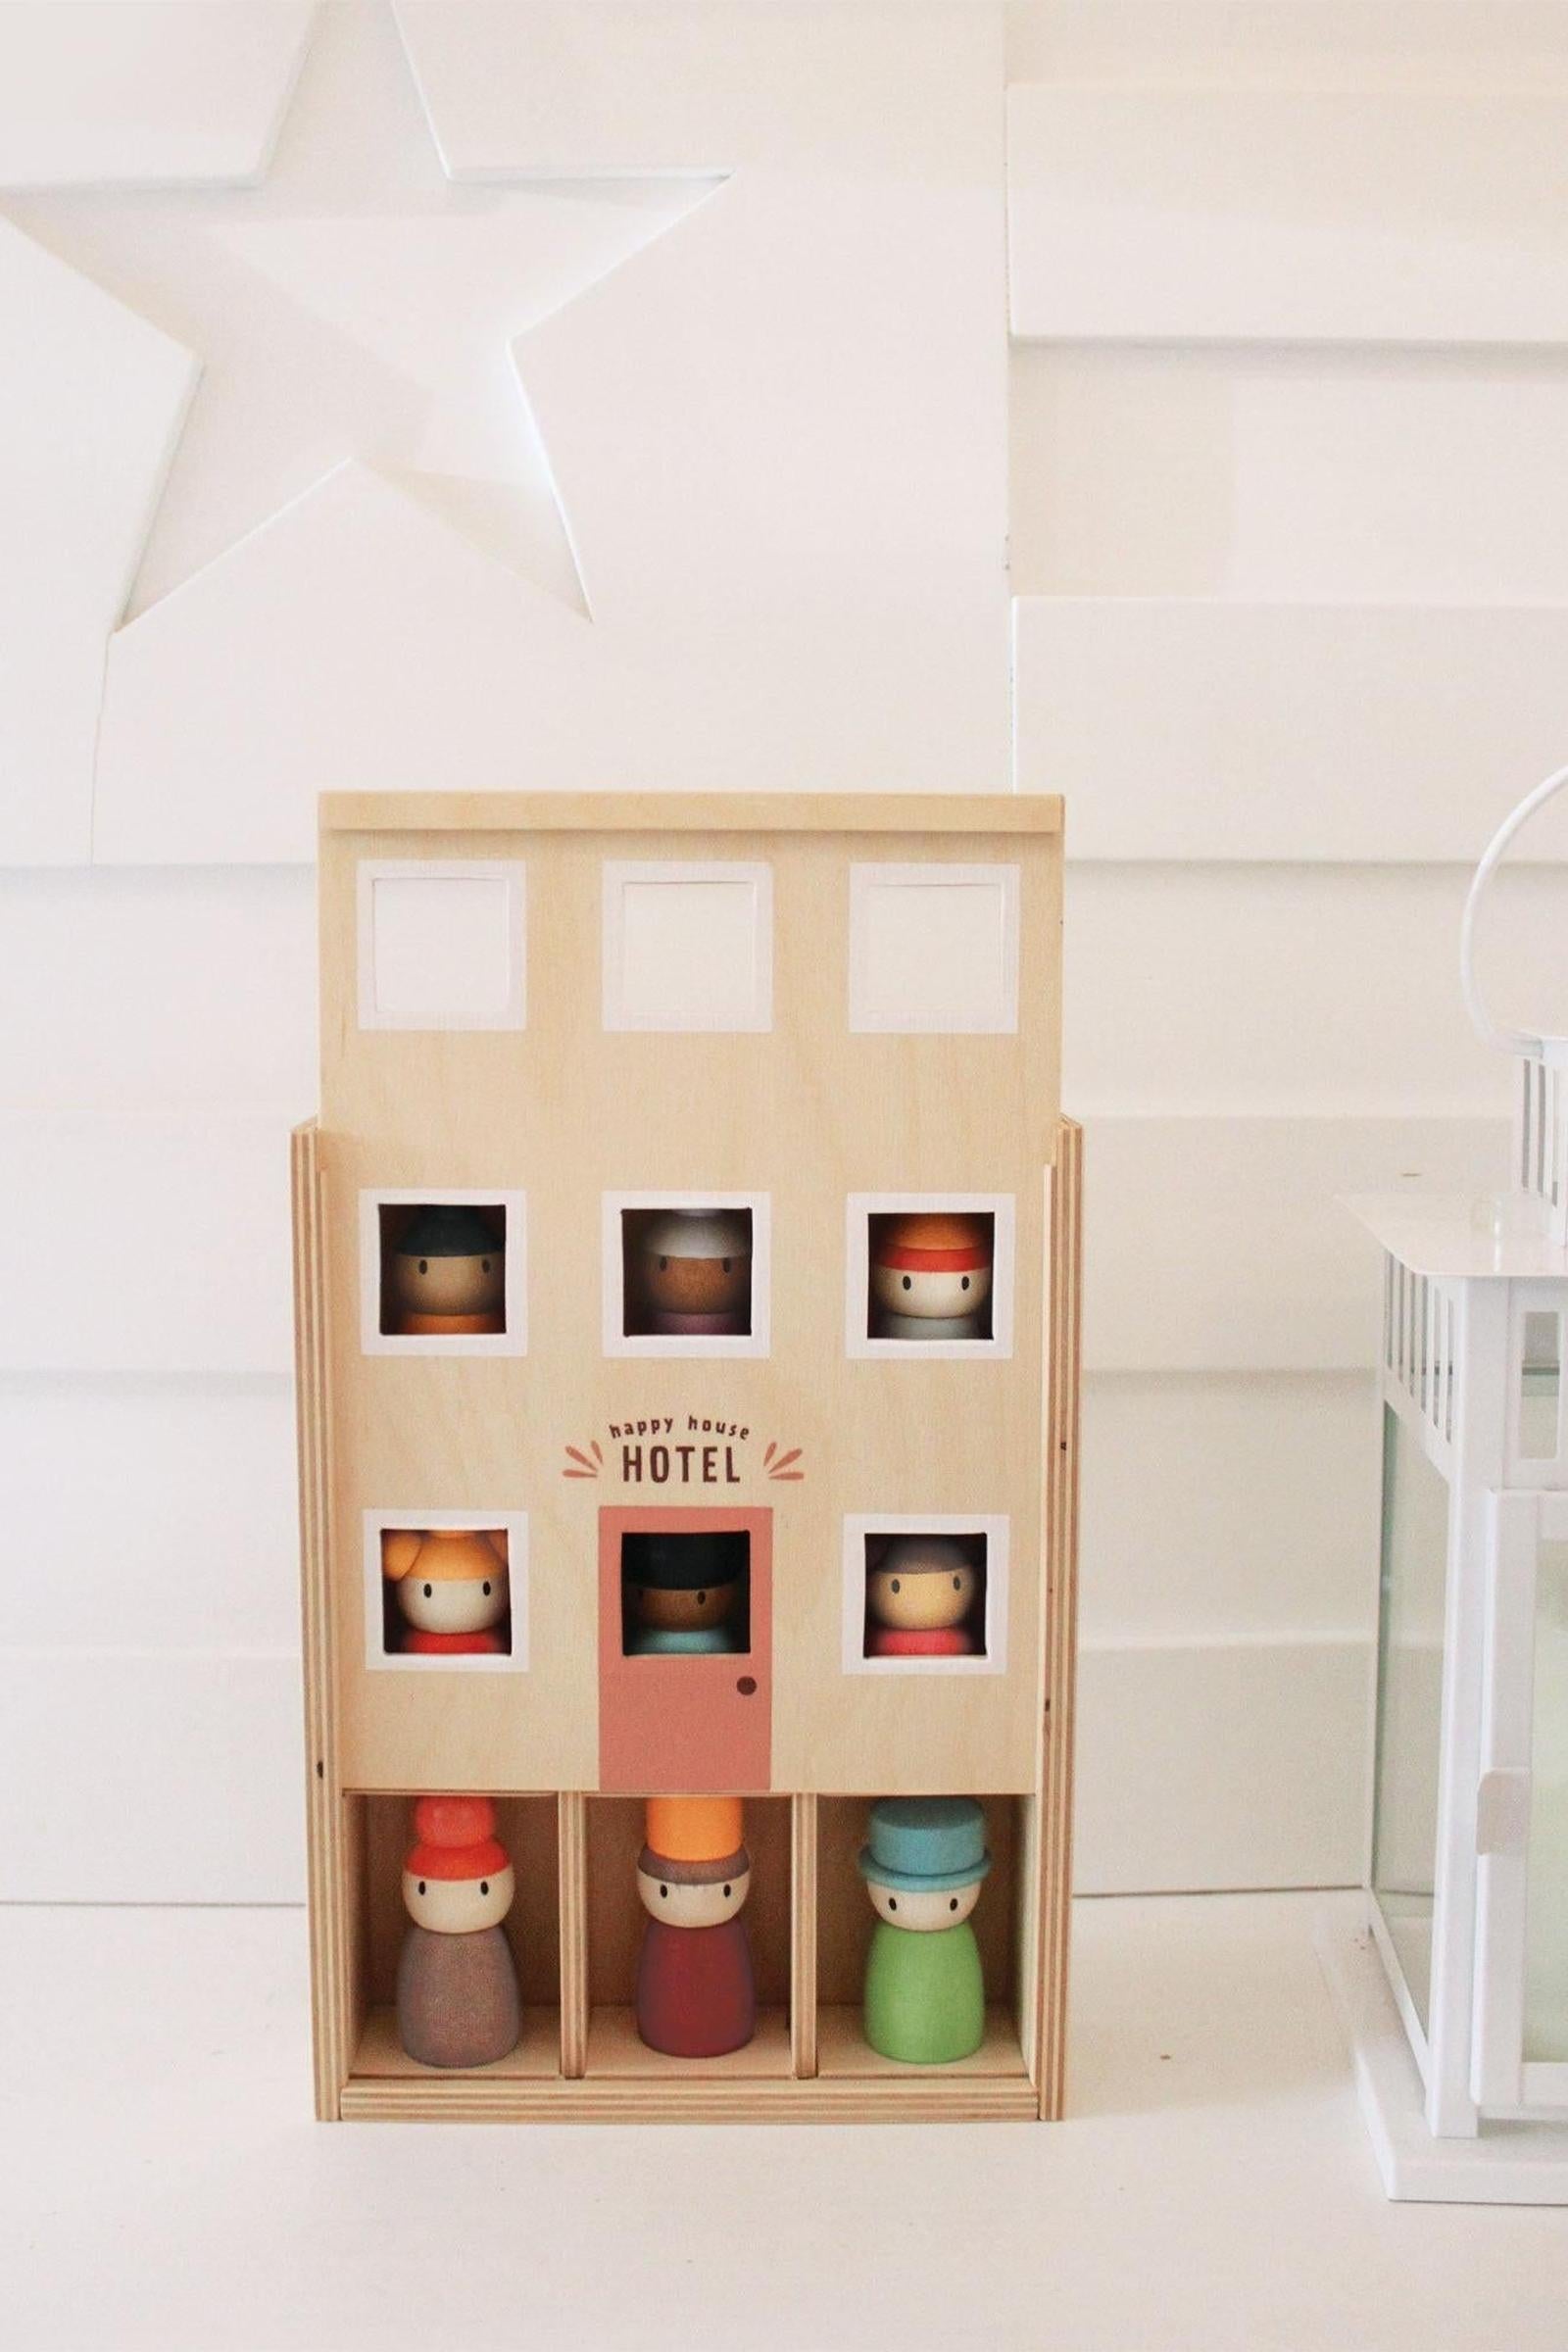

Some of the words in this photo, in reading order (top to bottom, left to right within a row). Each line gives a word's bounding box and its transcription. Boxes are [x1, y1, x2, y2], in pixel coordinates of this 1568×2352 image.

[608, 1416, 674, 1440] happy
[687, 1414, 751, 1441] house
[622, 1445, 741, 1484] HOTEL
